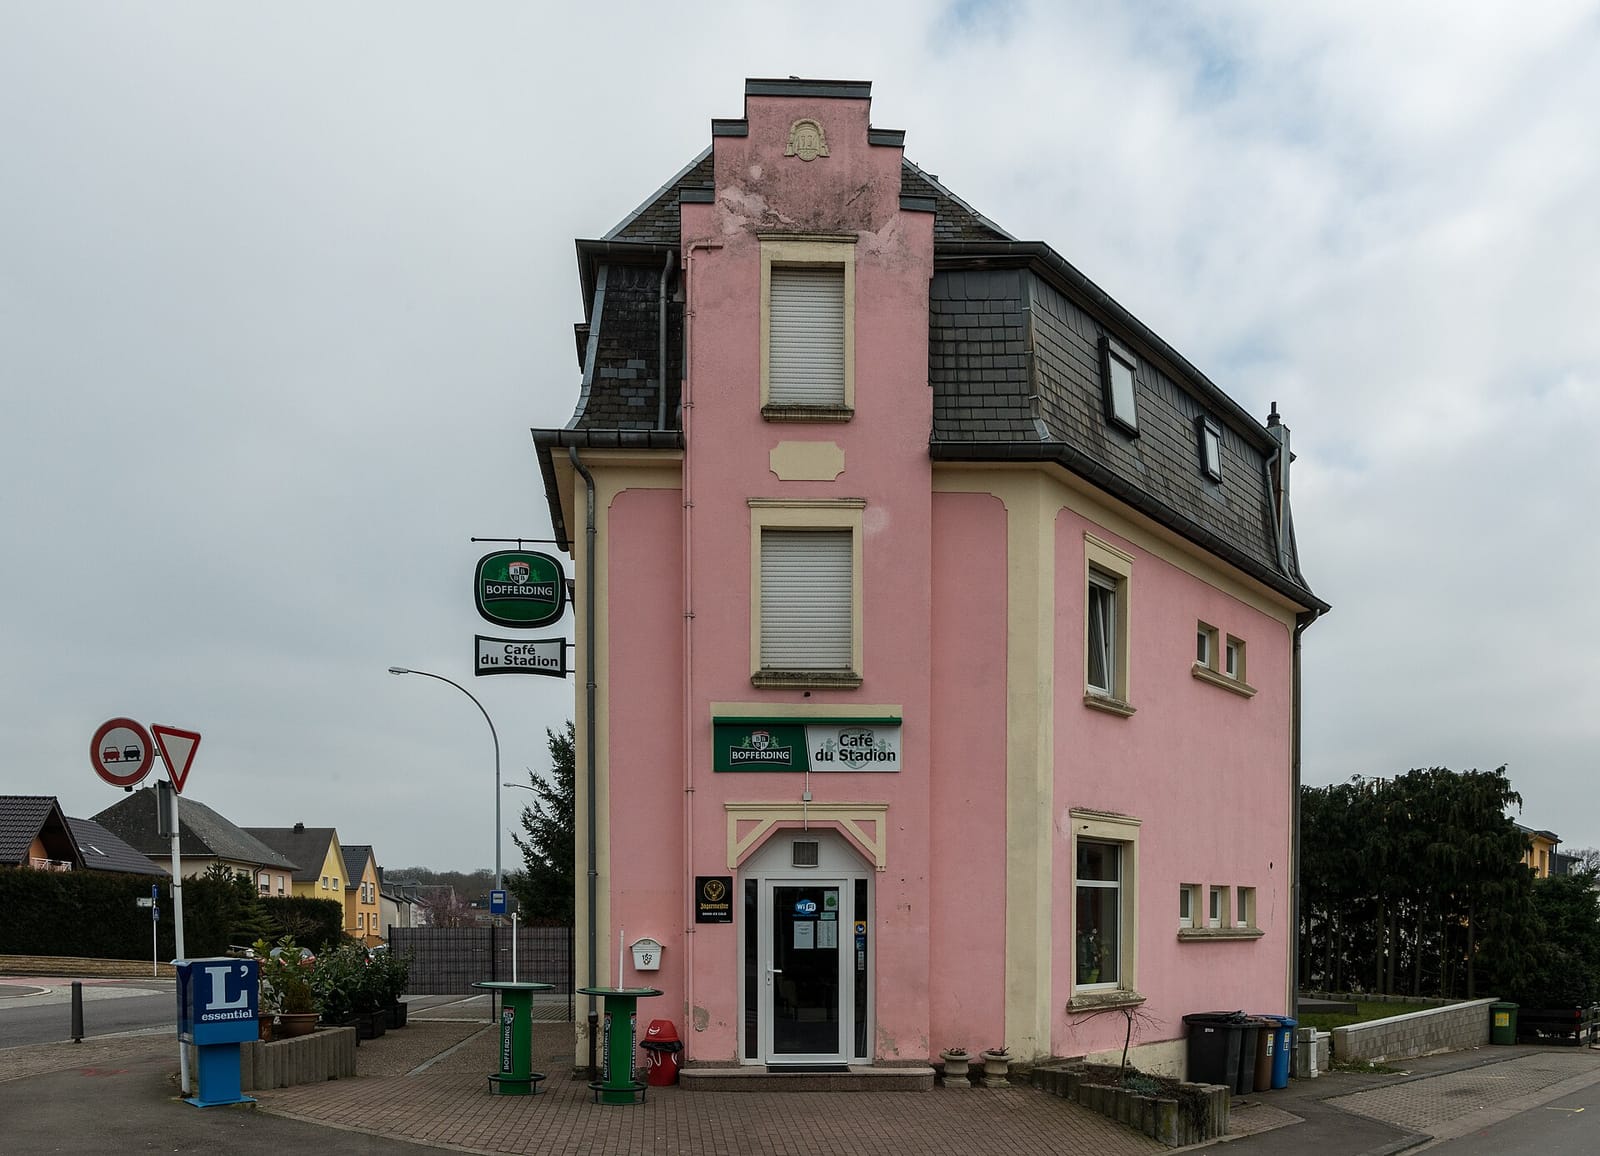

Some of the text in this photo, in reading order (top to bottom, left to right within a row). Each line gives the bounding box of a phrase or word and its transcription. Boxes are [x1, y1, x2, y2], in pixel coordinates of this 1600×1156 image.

[486, 585, 553, 596] BOFFERDING
[504, 644, 536, 655] Café
[481, 654, 558, 667] du Stadion
[839, 733, 873, 747] Café
[732, 751, 790, 760] BOFFERDING
[815, 749, 896, 762] du Stadion
[202, 1009, 253, 1021] essentiel
